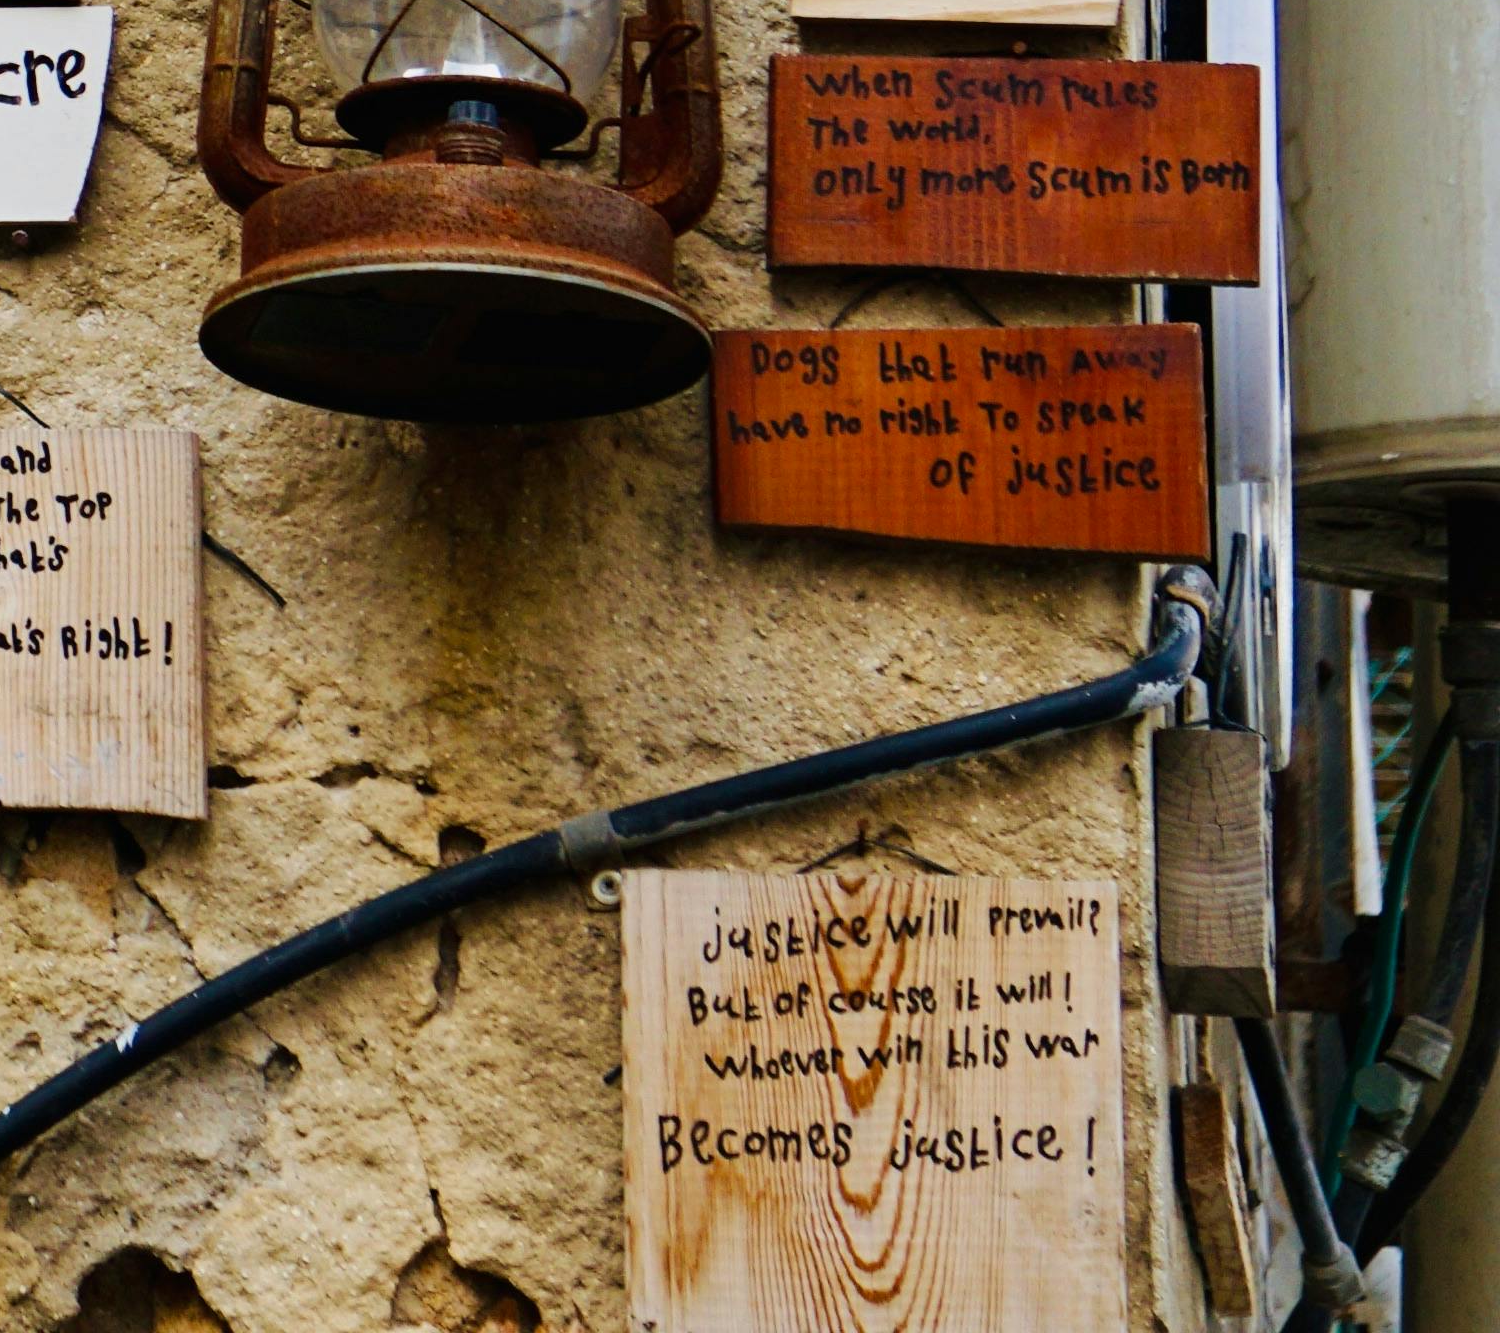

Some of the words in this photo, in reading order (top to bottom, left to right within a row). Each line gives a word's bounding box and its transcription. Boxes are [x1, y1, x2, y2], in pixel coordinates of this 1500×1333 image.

[981, 347, 1047, 377] run
[826, 412, 861, 435] no
[930, 452, 975, 494] of
